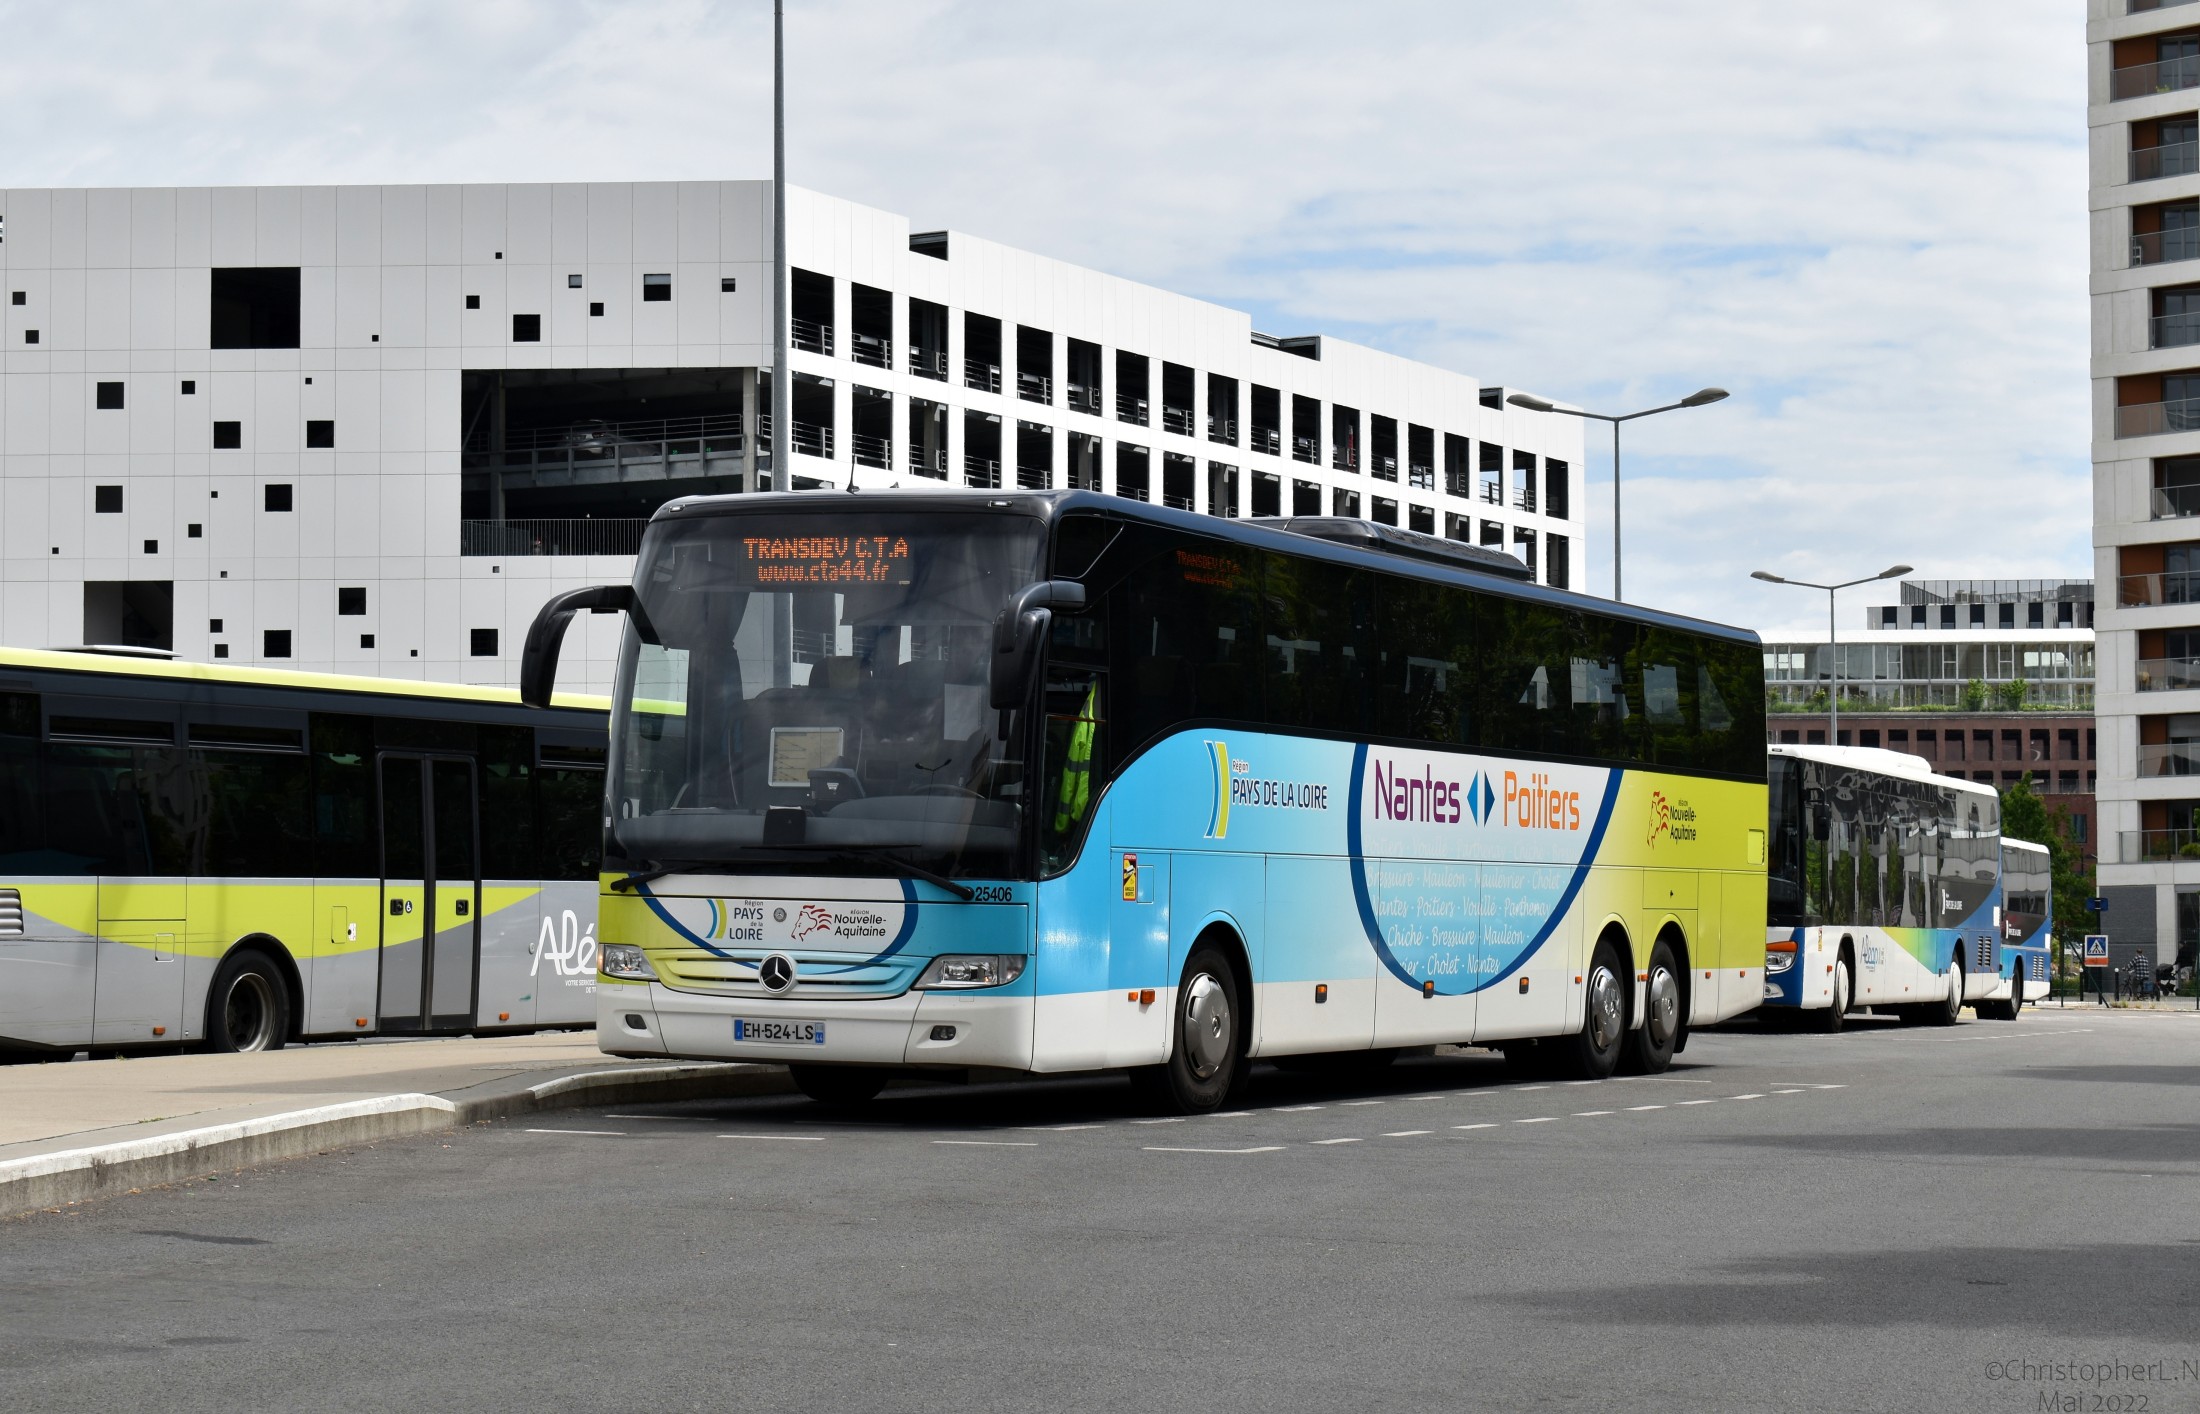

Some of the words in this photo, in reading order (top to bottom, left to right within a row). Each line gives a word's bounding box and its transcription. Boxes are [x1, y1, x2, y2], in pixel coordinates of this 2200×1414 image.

[743, 537, 848, 558] TRANSDEV
[855, 537, 908, 558] C.T.A
[758, 560, 890, 581] www.cta44.fr
[1232, 760, 1249, 773] Région
[1232, 778, 1260, 805] PAYS
[1263, 780, 1278, 806] DE
[1281, 782, 1295, 807] LA
[1297, 783, 1328, 810] LOIRE
[1375, 759, 1461, 824] Nantes
[1503, 770, 1580, 831] Poitiers
[1669, 824, 1697, 845] Aquitaine
[974, 886, 1013, 902] 25406
[734, 908, 764, 920] PAYS
[1417, 896, 1455, 918] Poitiers
[1463, 895, 1496, 917] Vouillé
[1504, 896, 1551, 918] Parthenay
[834, 914, 887, 926] Nouvelle-
[729, 928, 763, 941] LOIRE
[834, 926, 887, 939] Aquitaine
[1387, 924, 1424, 947] Chiché
[1431, 926, 1476, 947] Bressuire
[1483, 924, 1525, 946] Mauléon
[1427, 953, 1460, 975] Cholet
[1466, 953, 1501, 975] Nantes
[743, 1022, 814, 1040] EH-524-LS
